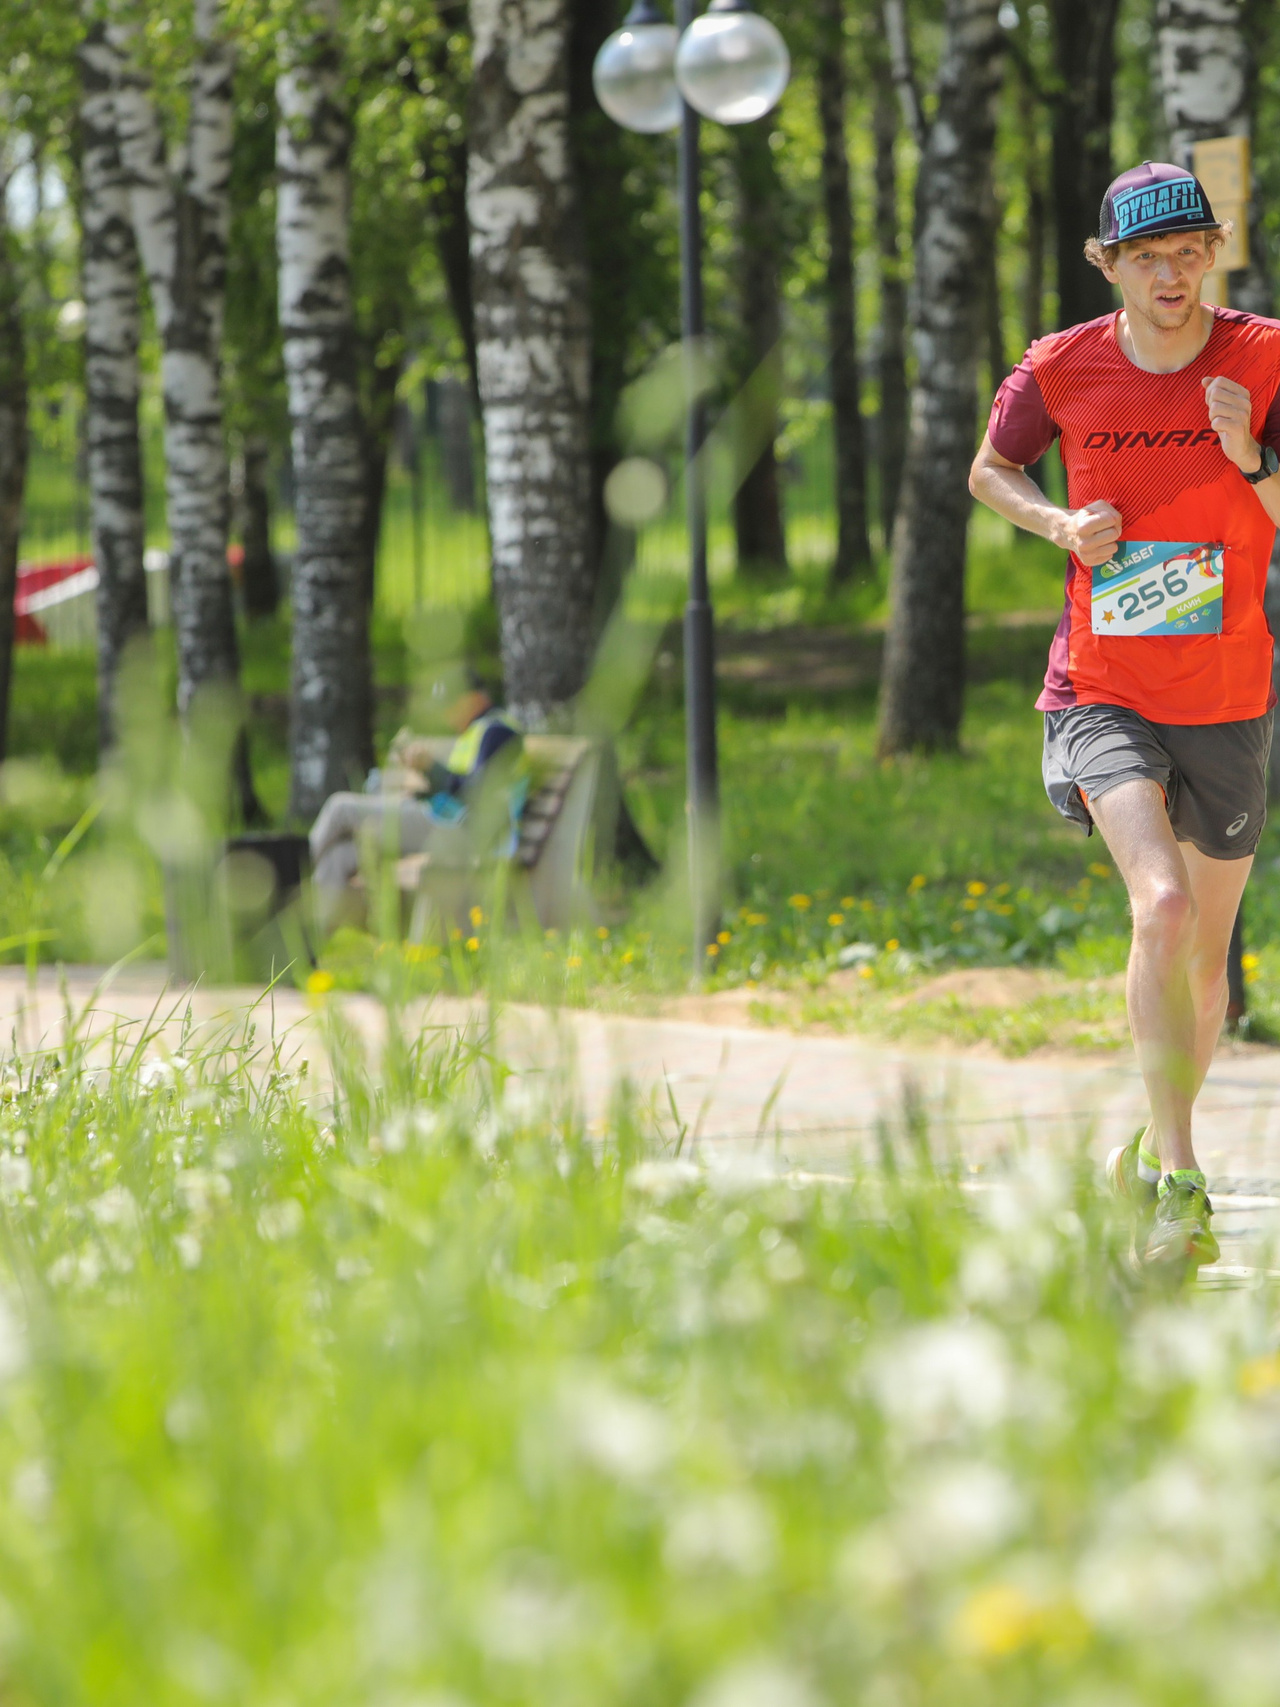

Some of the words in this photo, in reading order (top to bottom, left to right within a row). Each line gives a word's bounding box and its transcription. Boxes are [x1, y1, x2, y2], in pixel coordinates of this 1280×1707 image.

[1119, 183, 1196, 228] DYNAFIT
[1118, 569, 1188, 621] 256
[1176, 597, 1202, 614] КЛИН
